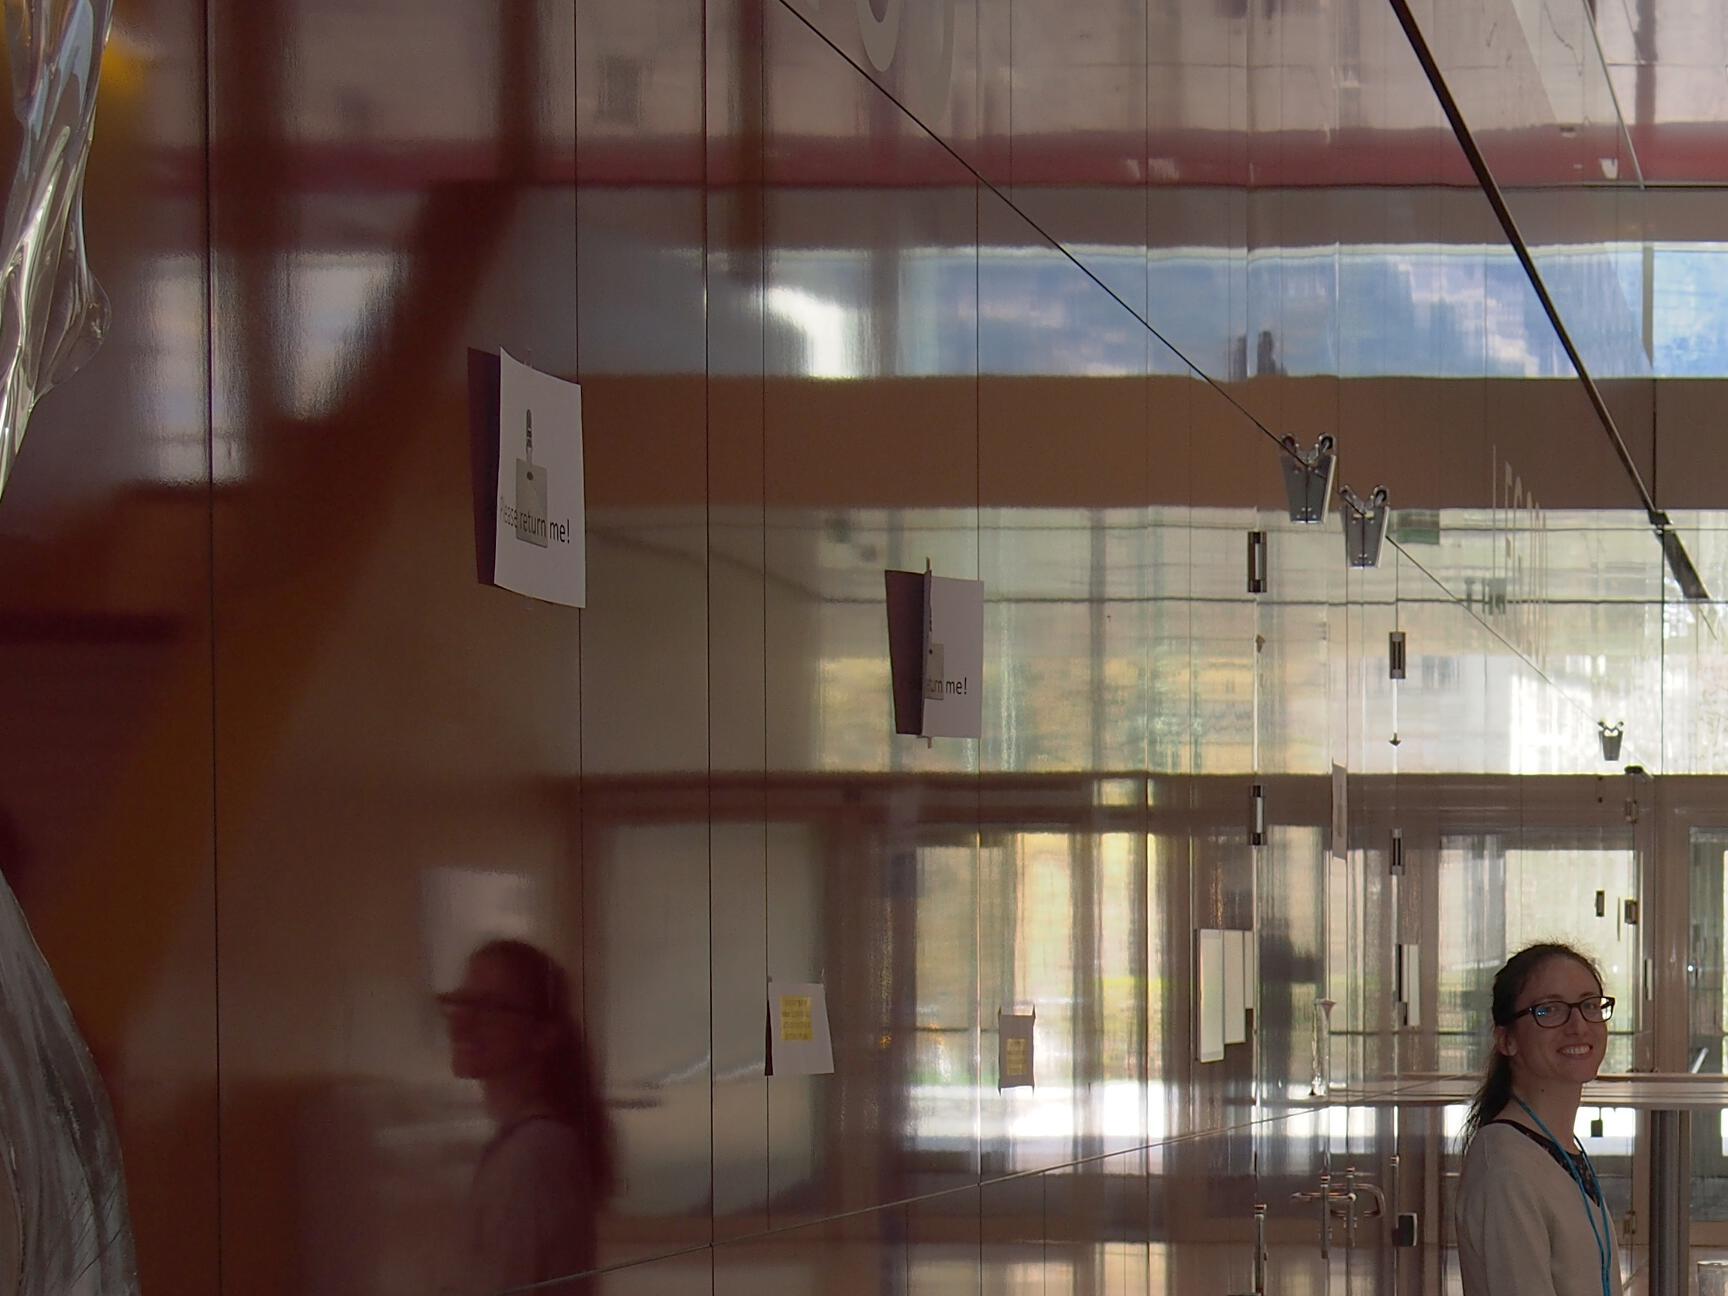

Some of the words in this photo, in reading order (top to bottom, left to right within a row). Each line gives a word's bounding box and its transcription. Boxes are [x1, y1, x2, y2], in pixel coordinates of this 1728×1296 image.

[519, 510, 547, 538] return
[549, 518, 570, 545] me!
[945, 676, 967, 695] me!
